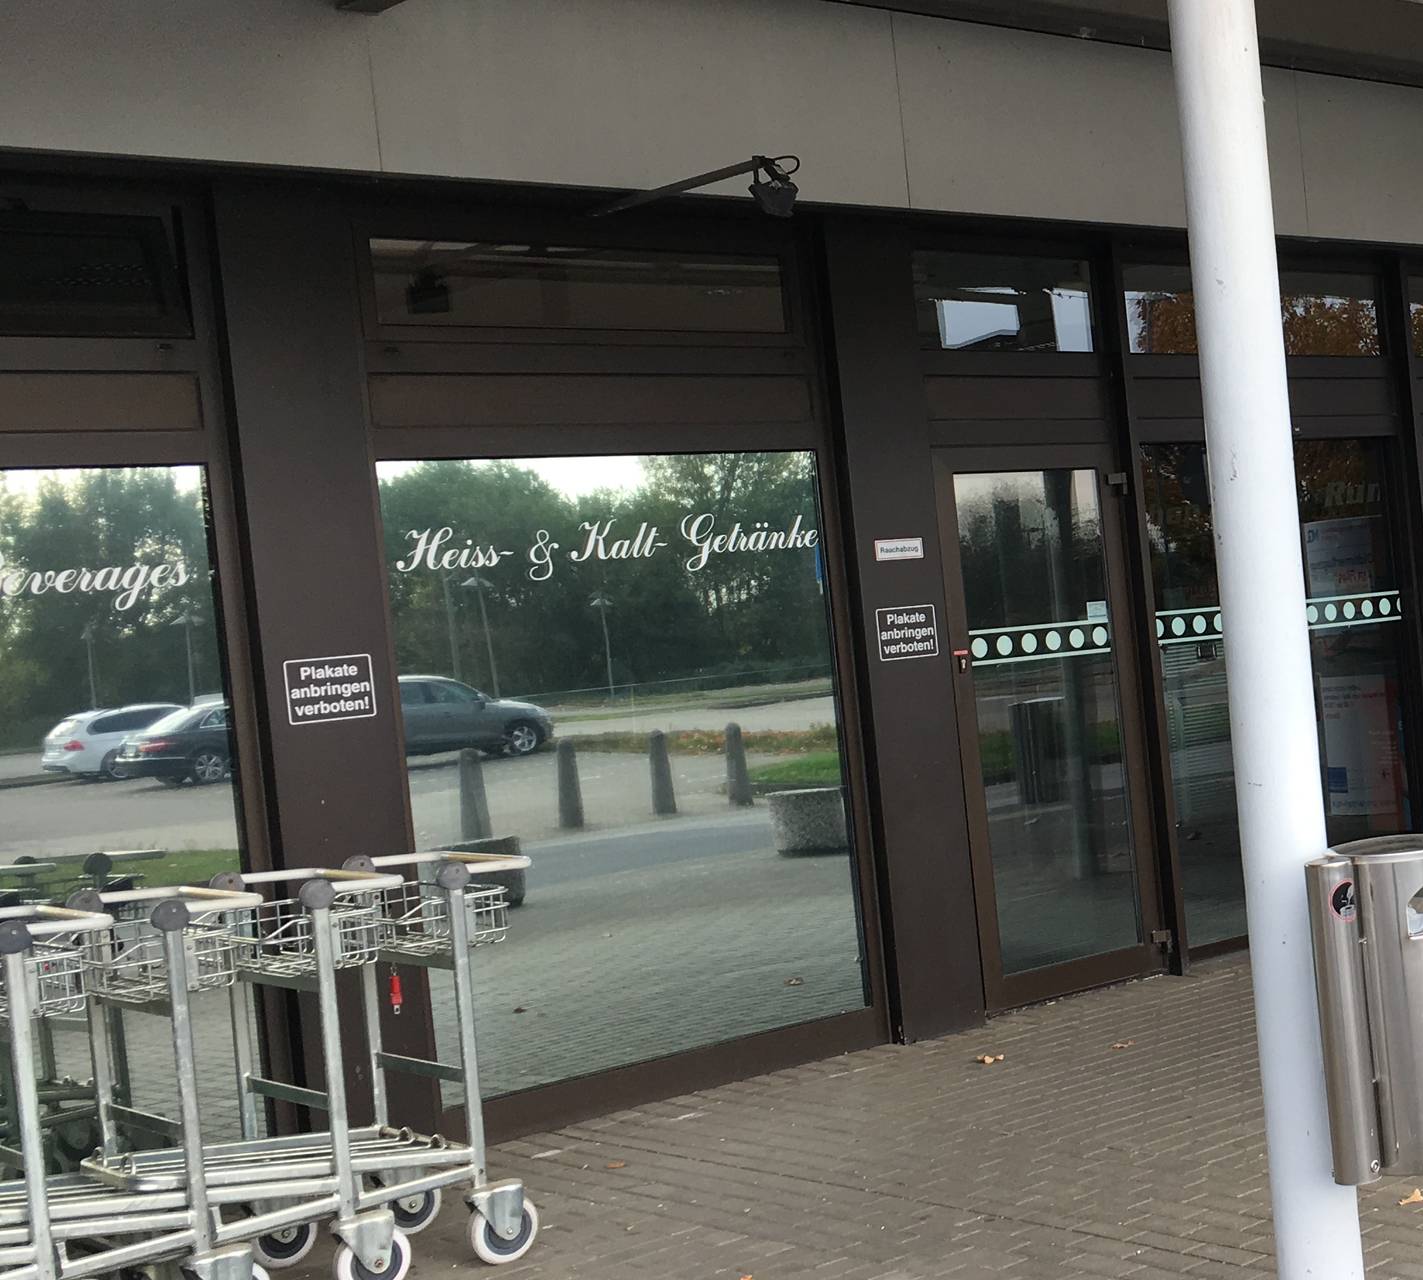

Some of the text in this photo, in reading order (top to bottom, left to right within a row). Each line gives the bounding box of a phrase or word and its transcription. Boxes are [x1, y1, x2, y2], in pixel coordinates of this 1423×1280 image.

[396, 513, 819, 581] Heiss- & Kalt- Getränke
[880, 546, 919, 554] Rauchabzug
[0, 561, 190, 611] everages
[886, 612, 926, 625] Plakate
[881, 627, 934, 641] anbringen
[883, 639, 934, 654] verboten!
[300, 664, 358, 680] Plakate
[290, 681, 370, 699] anbringen
[294, 696, 370, 716] verboten!
